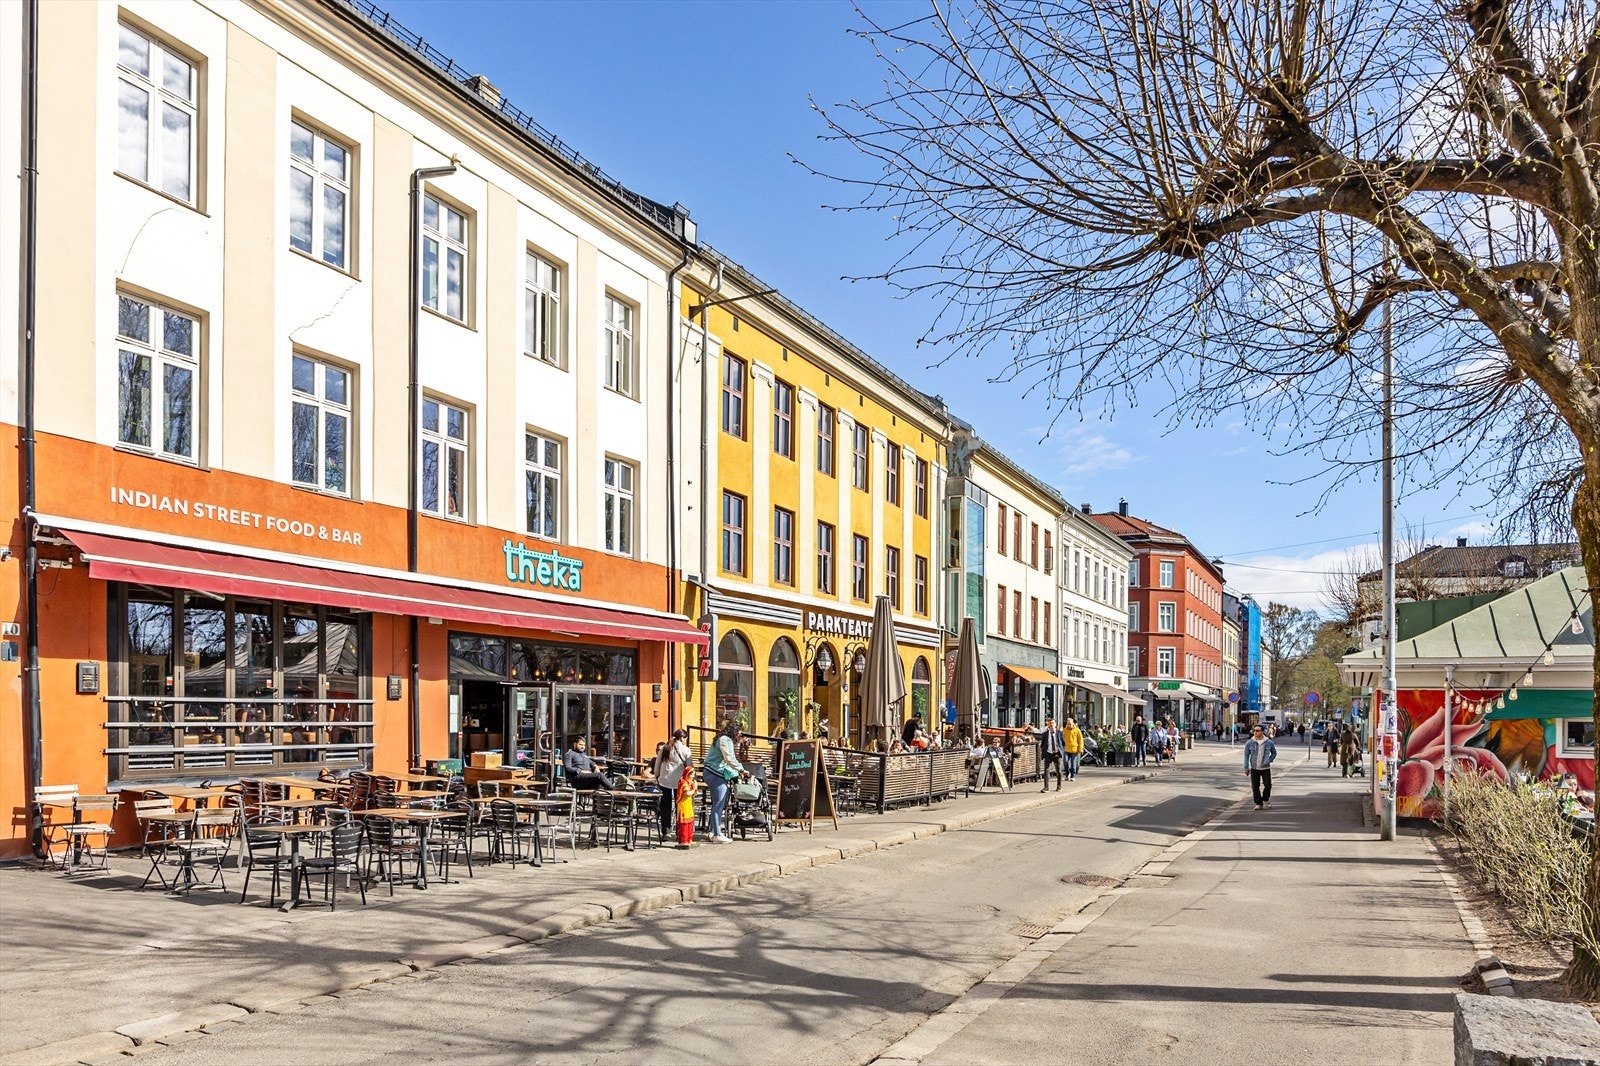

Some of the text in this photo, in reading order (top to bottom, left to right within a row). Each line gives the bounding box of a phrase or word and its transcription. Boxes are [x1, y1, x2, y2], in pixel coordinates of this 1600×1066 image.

[110, 486, 362, 546] INDIAN STREET FOOD & BAR
[503, 540, 583, 592] theka
[4, 623, 19, 635] 10
